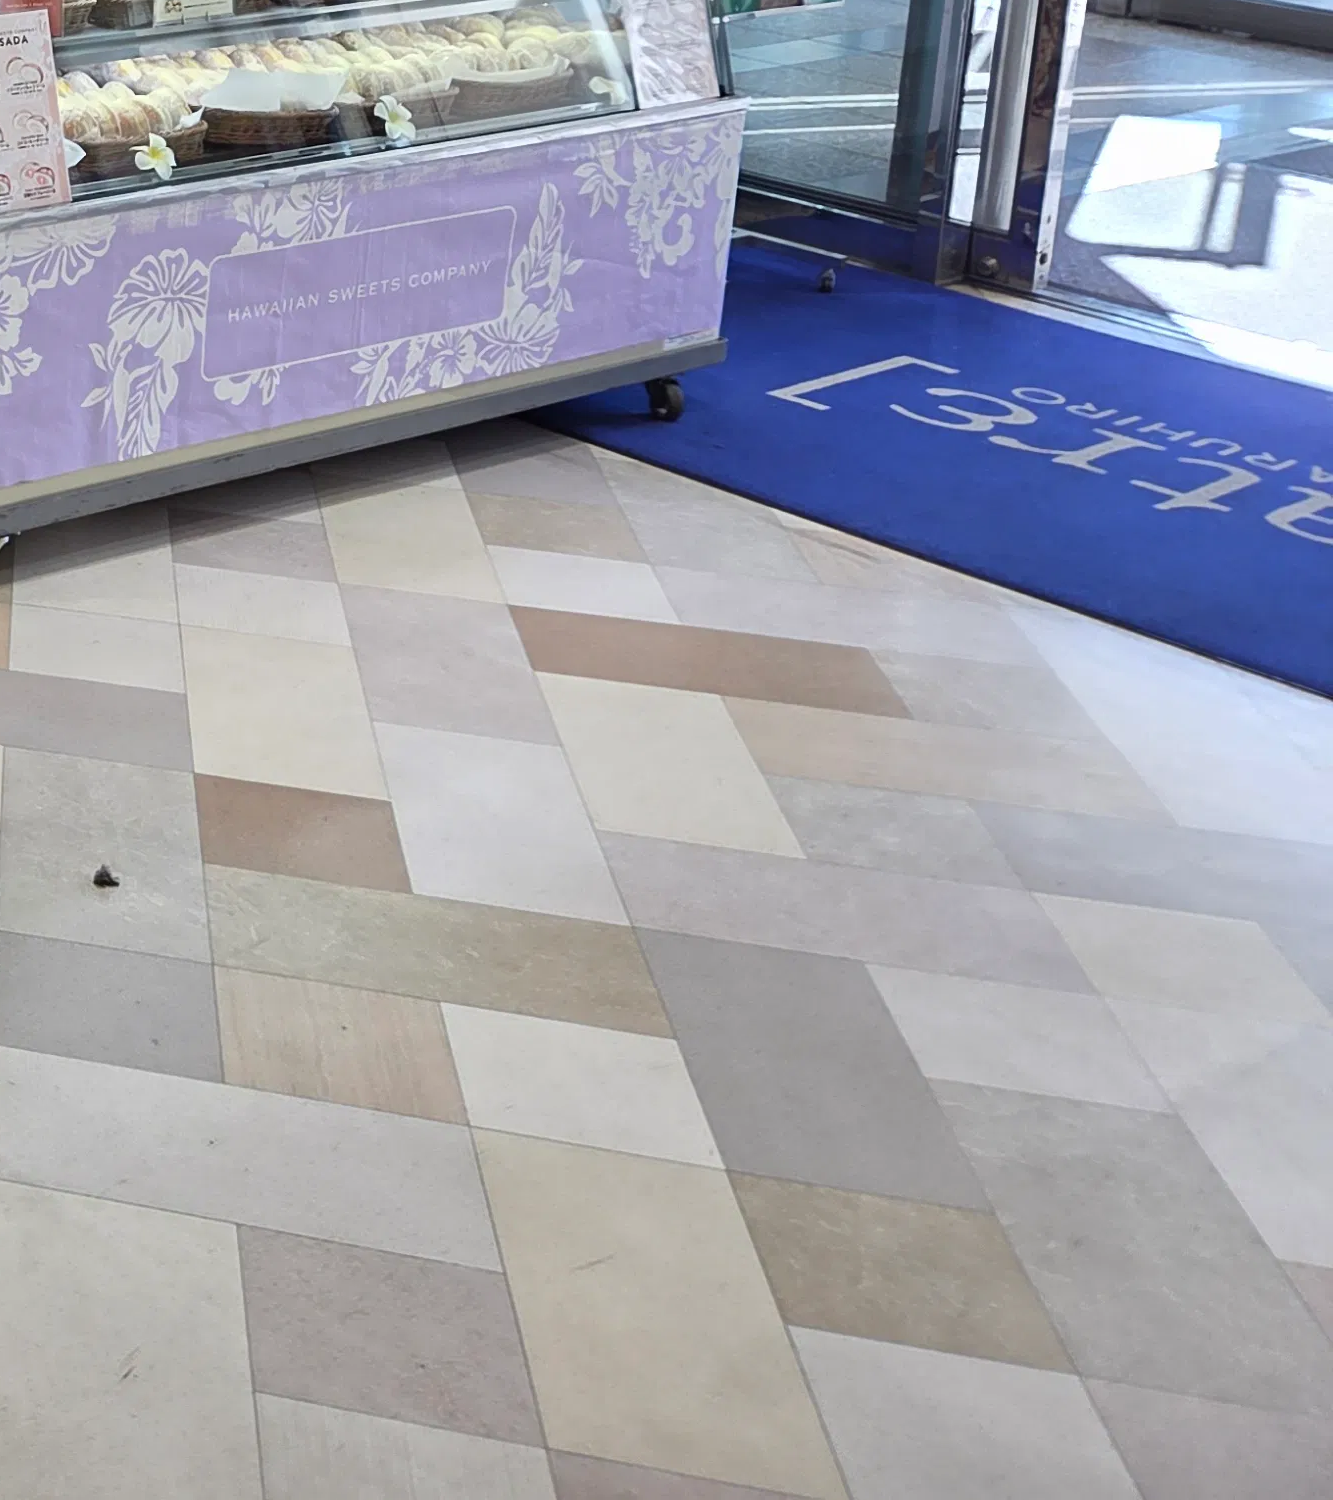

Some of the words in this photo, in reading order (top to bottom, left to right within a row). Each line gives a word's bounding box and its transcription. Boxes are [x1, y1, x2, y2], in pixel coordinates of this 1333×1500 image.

[227, 293, 319, 324] HAWAIIAN
[328, 278, 401, 304] SWEETS
[408, 260, 492, 288] COMPANY
